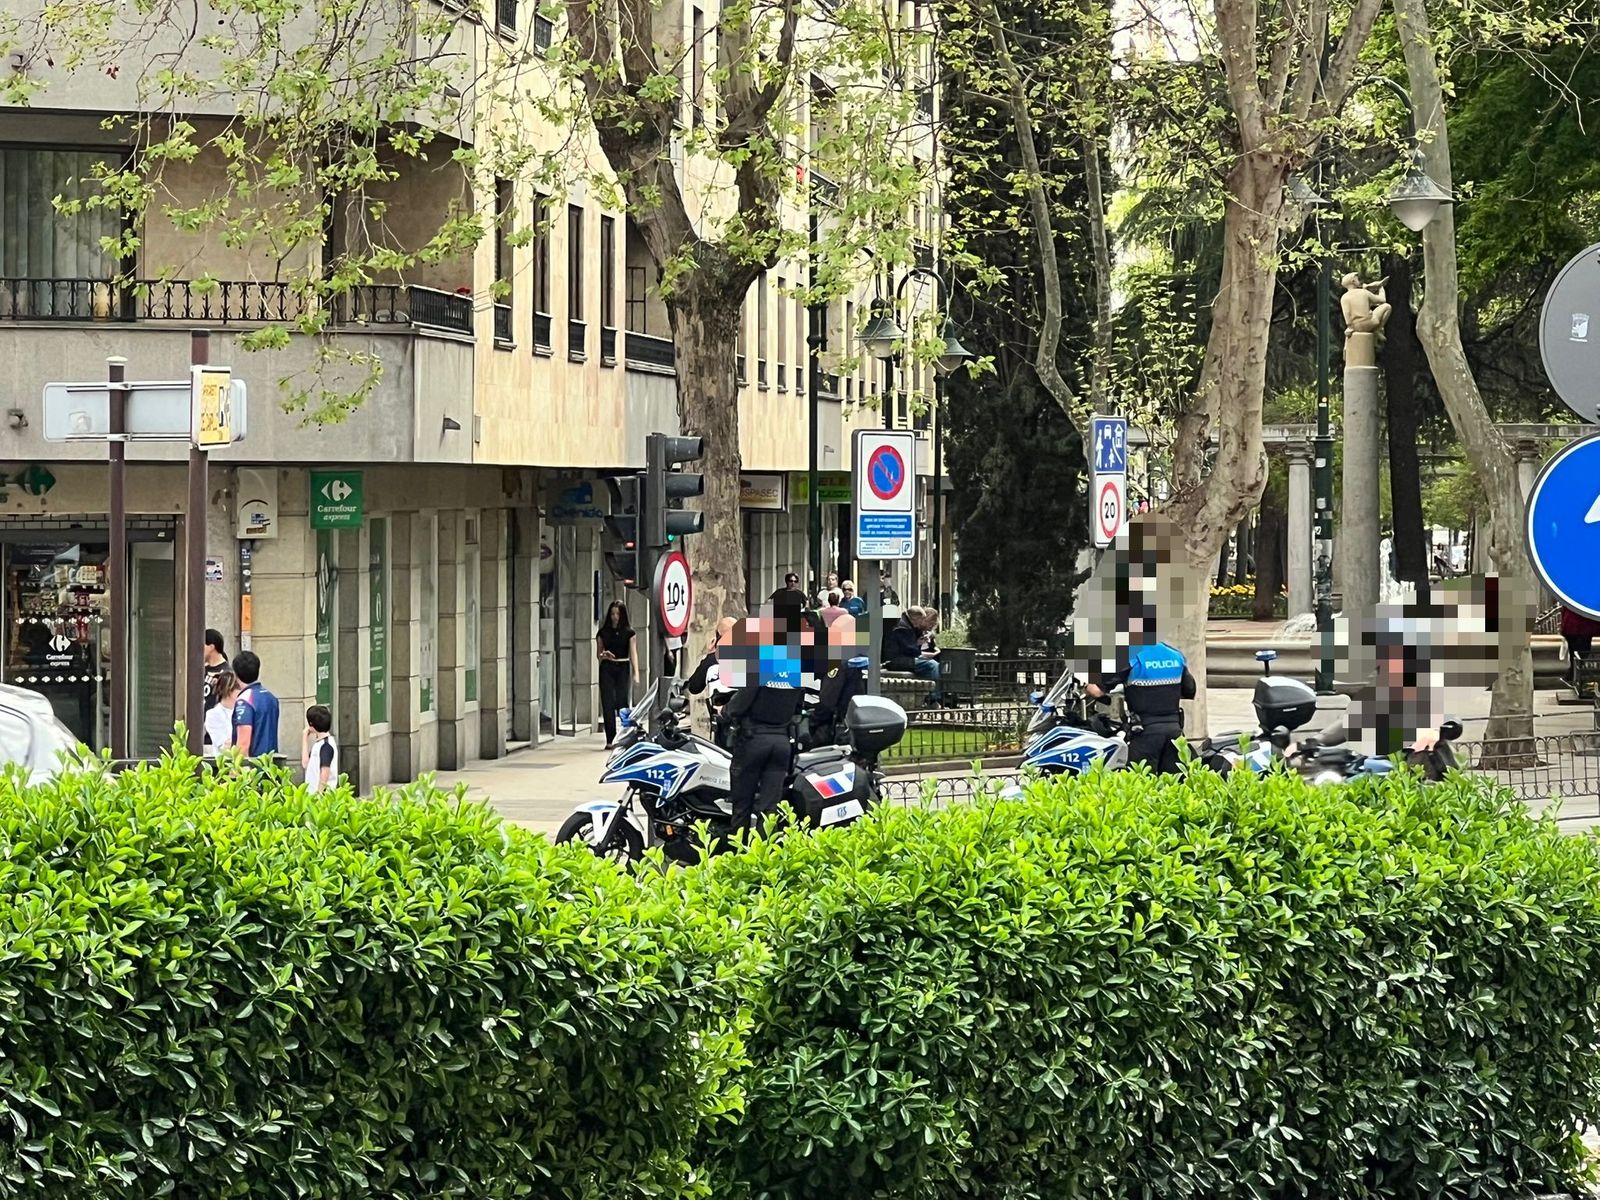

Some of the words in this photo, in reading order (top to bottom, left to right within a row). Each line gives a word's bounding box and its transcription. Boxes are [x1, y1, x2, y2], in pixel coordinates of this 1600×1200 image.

[317, 504, 358, 513] Carrefour
[1104, 502, 1116, 519] 20
[1060, 752, 1081, 763] 112
[645, 768, 665, 780] 112
